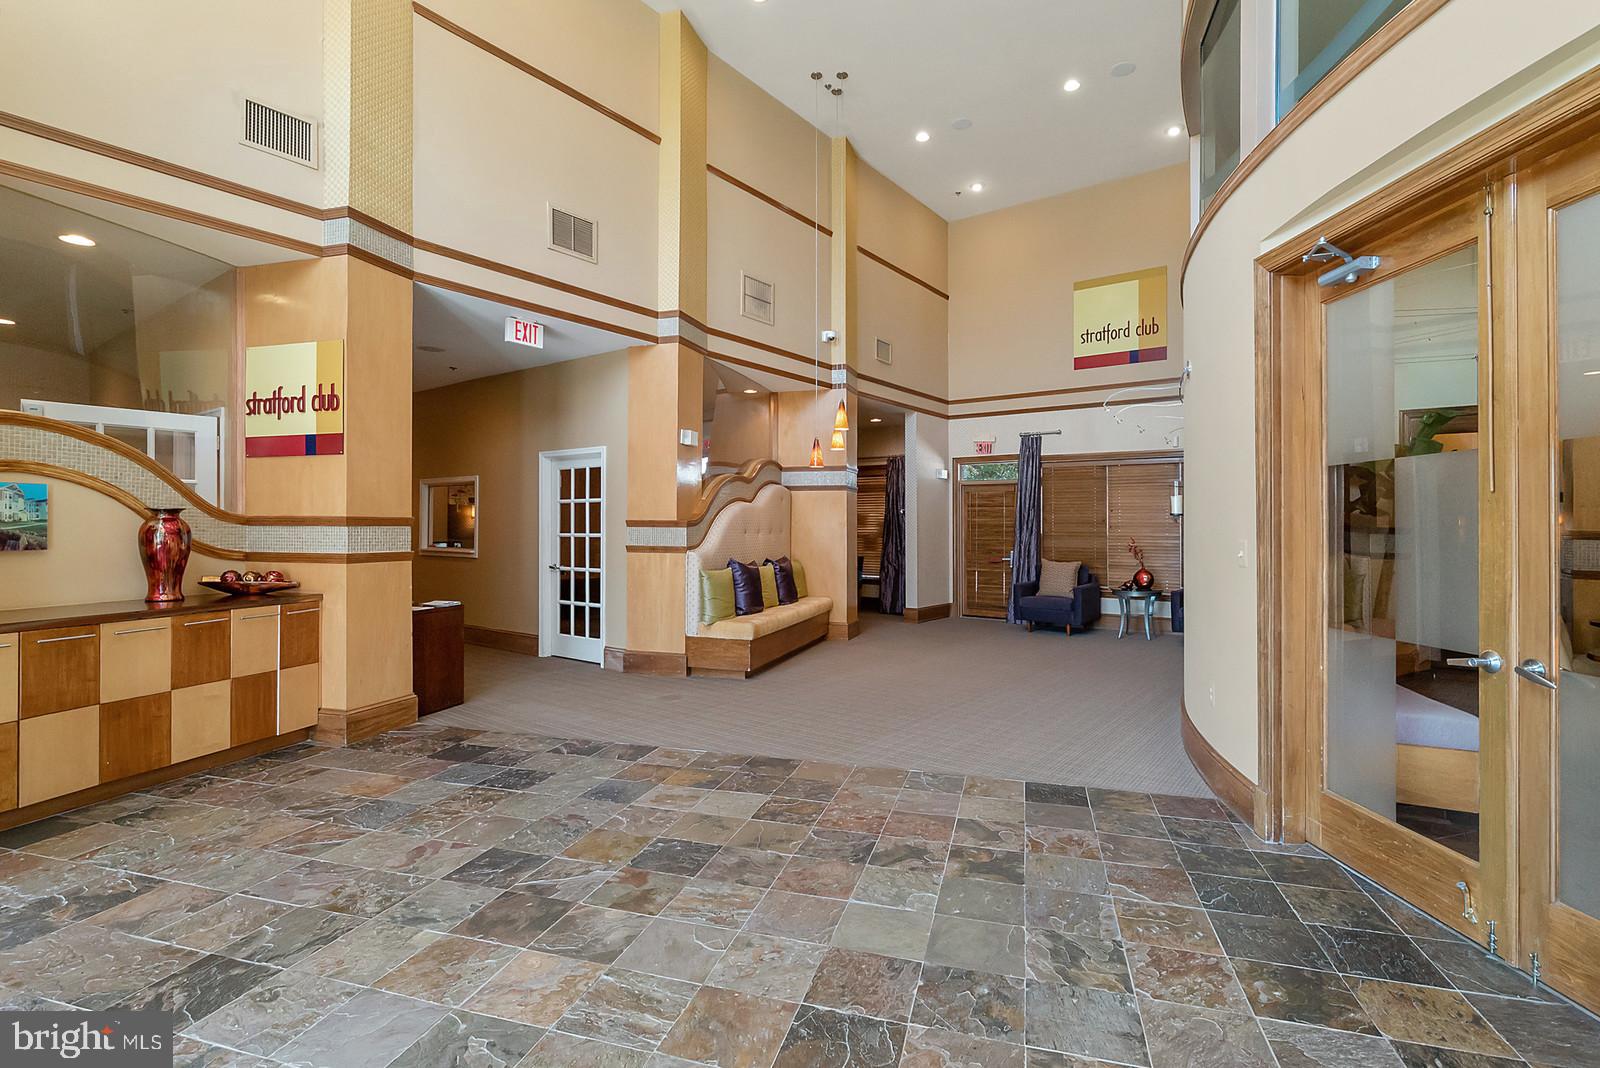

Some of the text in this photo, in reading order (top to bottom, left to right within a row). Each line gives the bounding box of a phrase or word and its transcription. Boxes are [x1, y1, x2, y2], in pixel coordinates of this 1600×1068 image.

[515, 320, 539, 345] EXIT
[1080, 316, 1159, 344] stratford club
[245, 385, 306, 420] stratford
[311, 383, 340, 412] club
